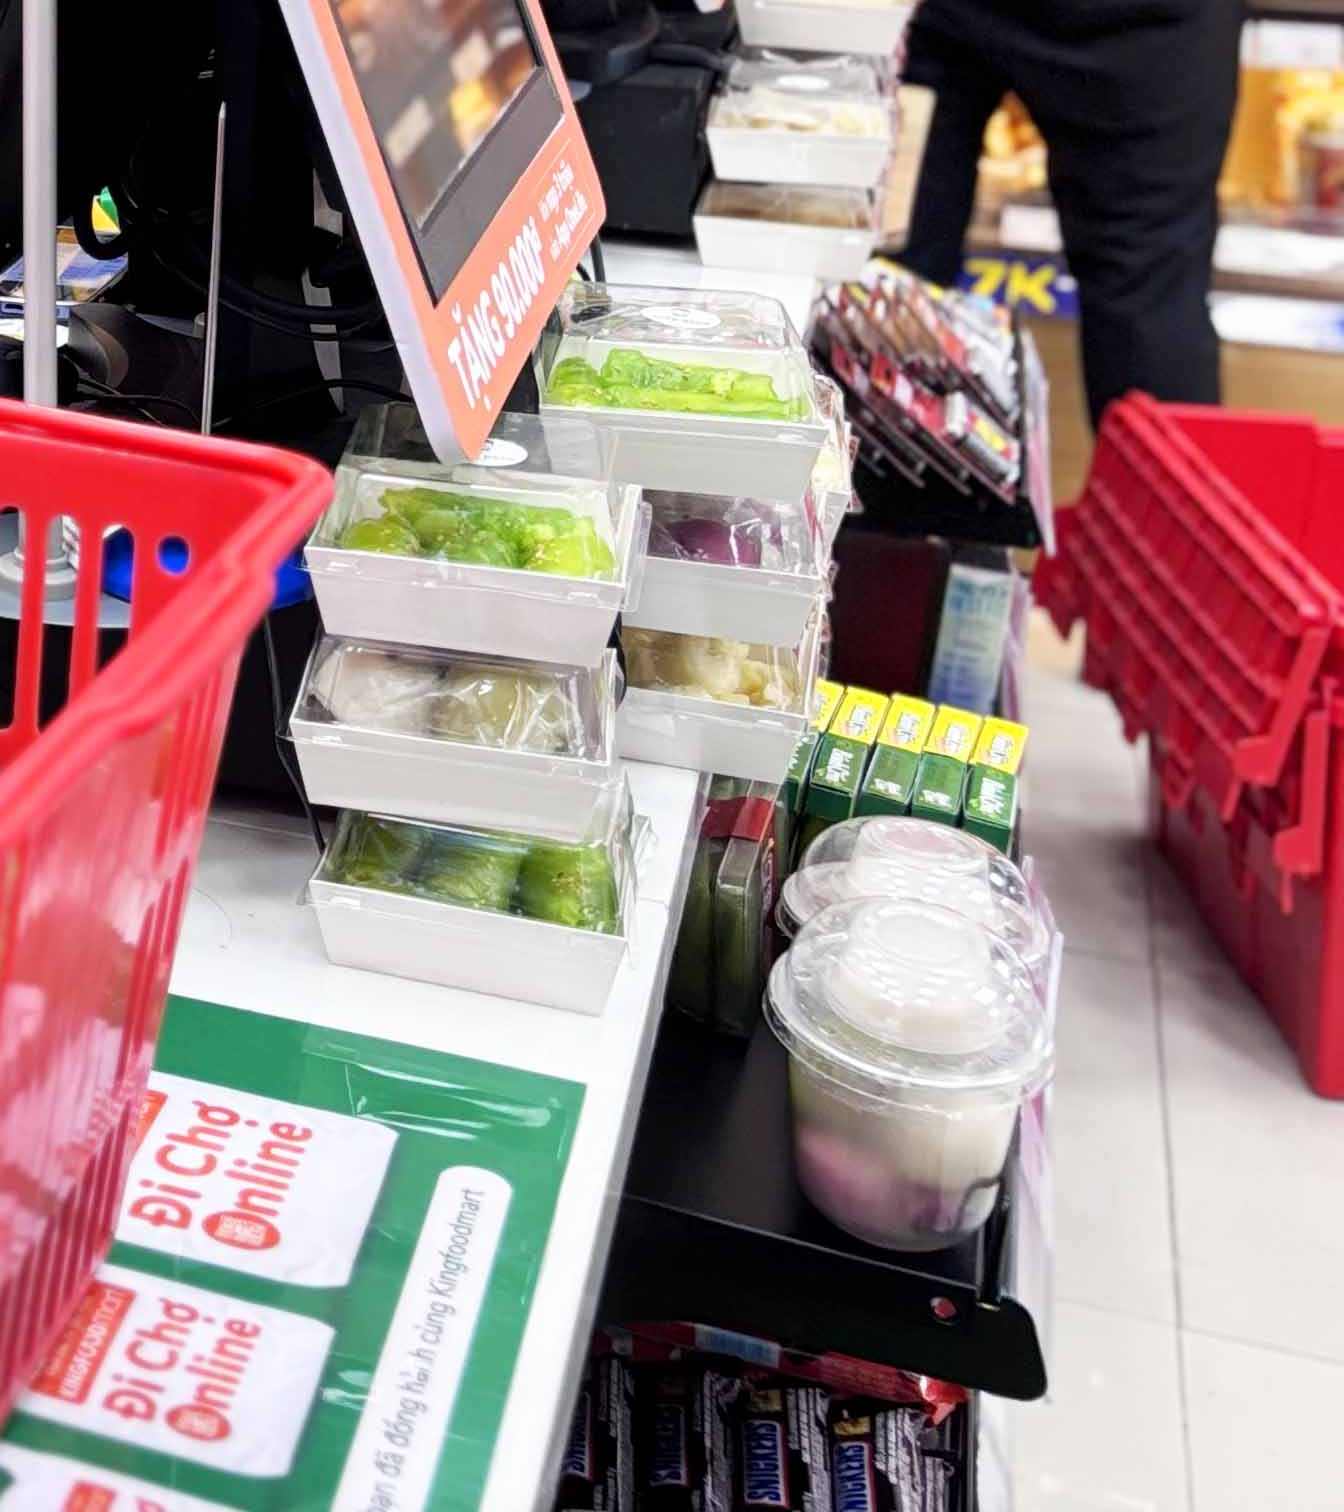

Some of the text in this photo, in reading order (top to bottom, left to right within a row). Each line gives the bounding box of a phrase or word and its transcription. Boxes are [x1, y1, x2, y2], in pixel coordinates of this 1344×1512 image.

[448, 290, 505, 412] TẶNG
[128, 1099, 259, 1230] Đi Chợ
[202, 1120, 312, 1250] Online
[429, 1188, 484, 1300] Kingfoodmart
[102, 1299, 215, 1421] Đi Chợ
[415, 1293, 456, 1344] cùng
[165, 1318, 262, 1442] Online
[374, 1450, 405, 1480] đã
[746, 1422, 783, 1502] SNICKERS
[835, 1443, 868, 1512] NICKERS
